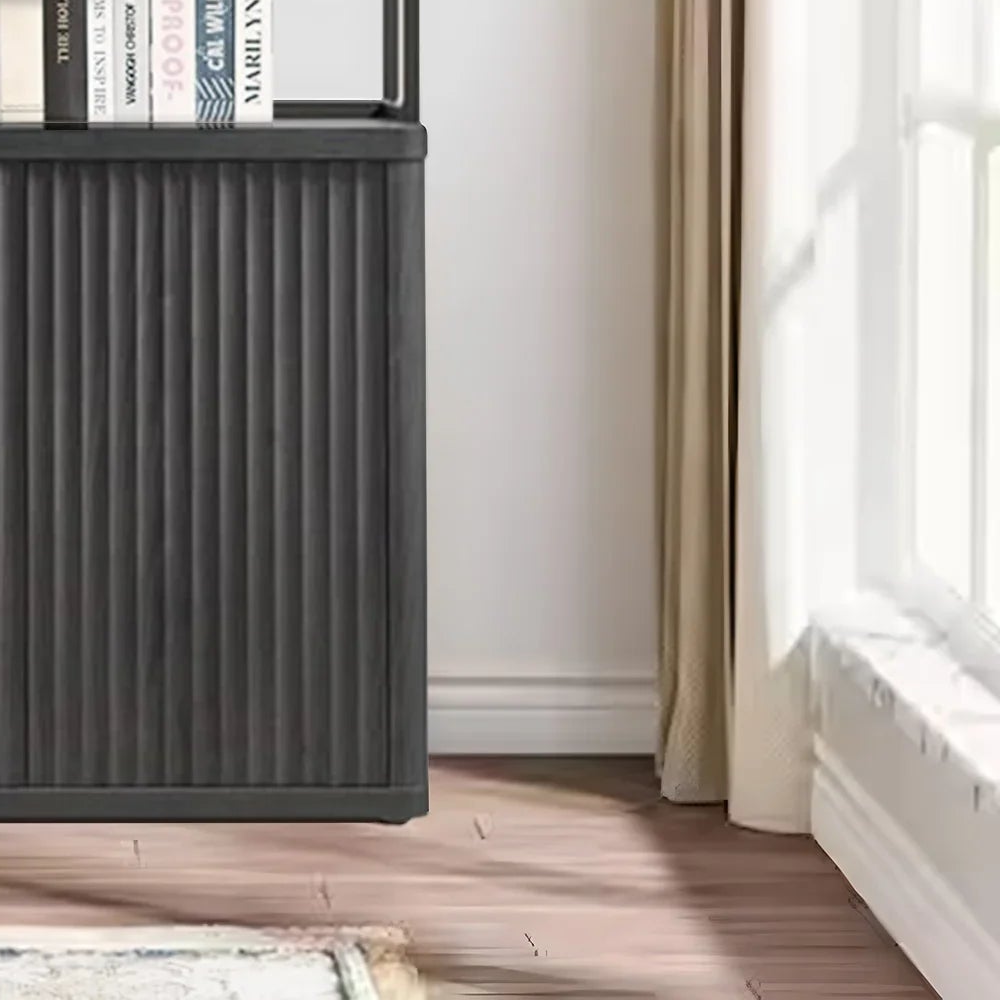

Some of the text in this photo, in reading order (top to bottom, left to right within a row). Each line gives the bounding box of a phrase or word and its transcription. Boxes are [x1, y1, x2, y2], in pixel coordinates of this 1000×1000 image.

[57, 32, 70, 64] THE
[93, 26, 106, 45] TO
[93, 51, 107, 115] INSPIRE
[125, 52, 137, 105] VANGOGH
